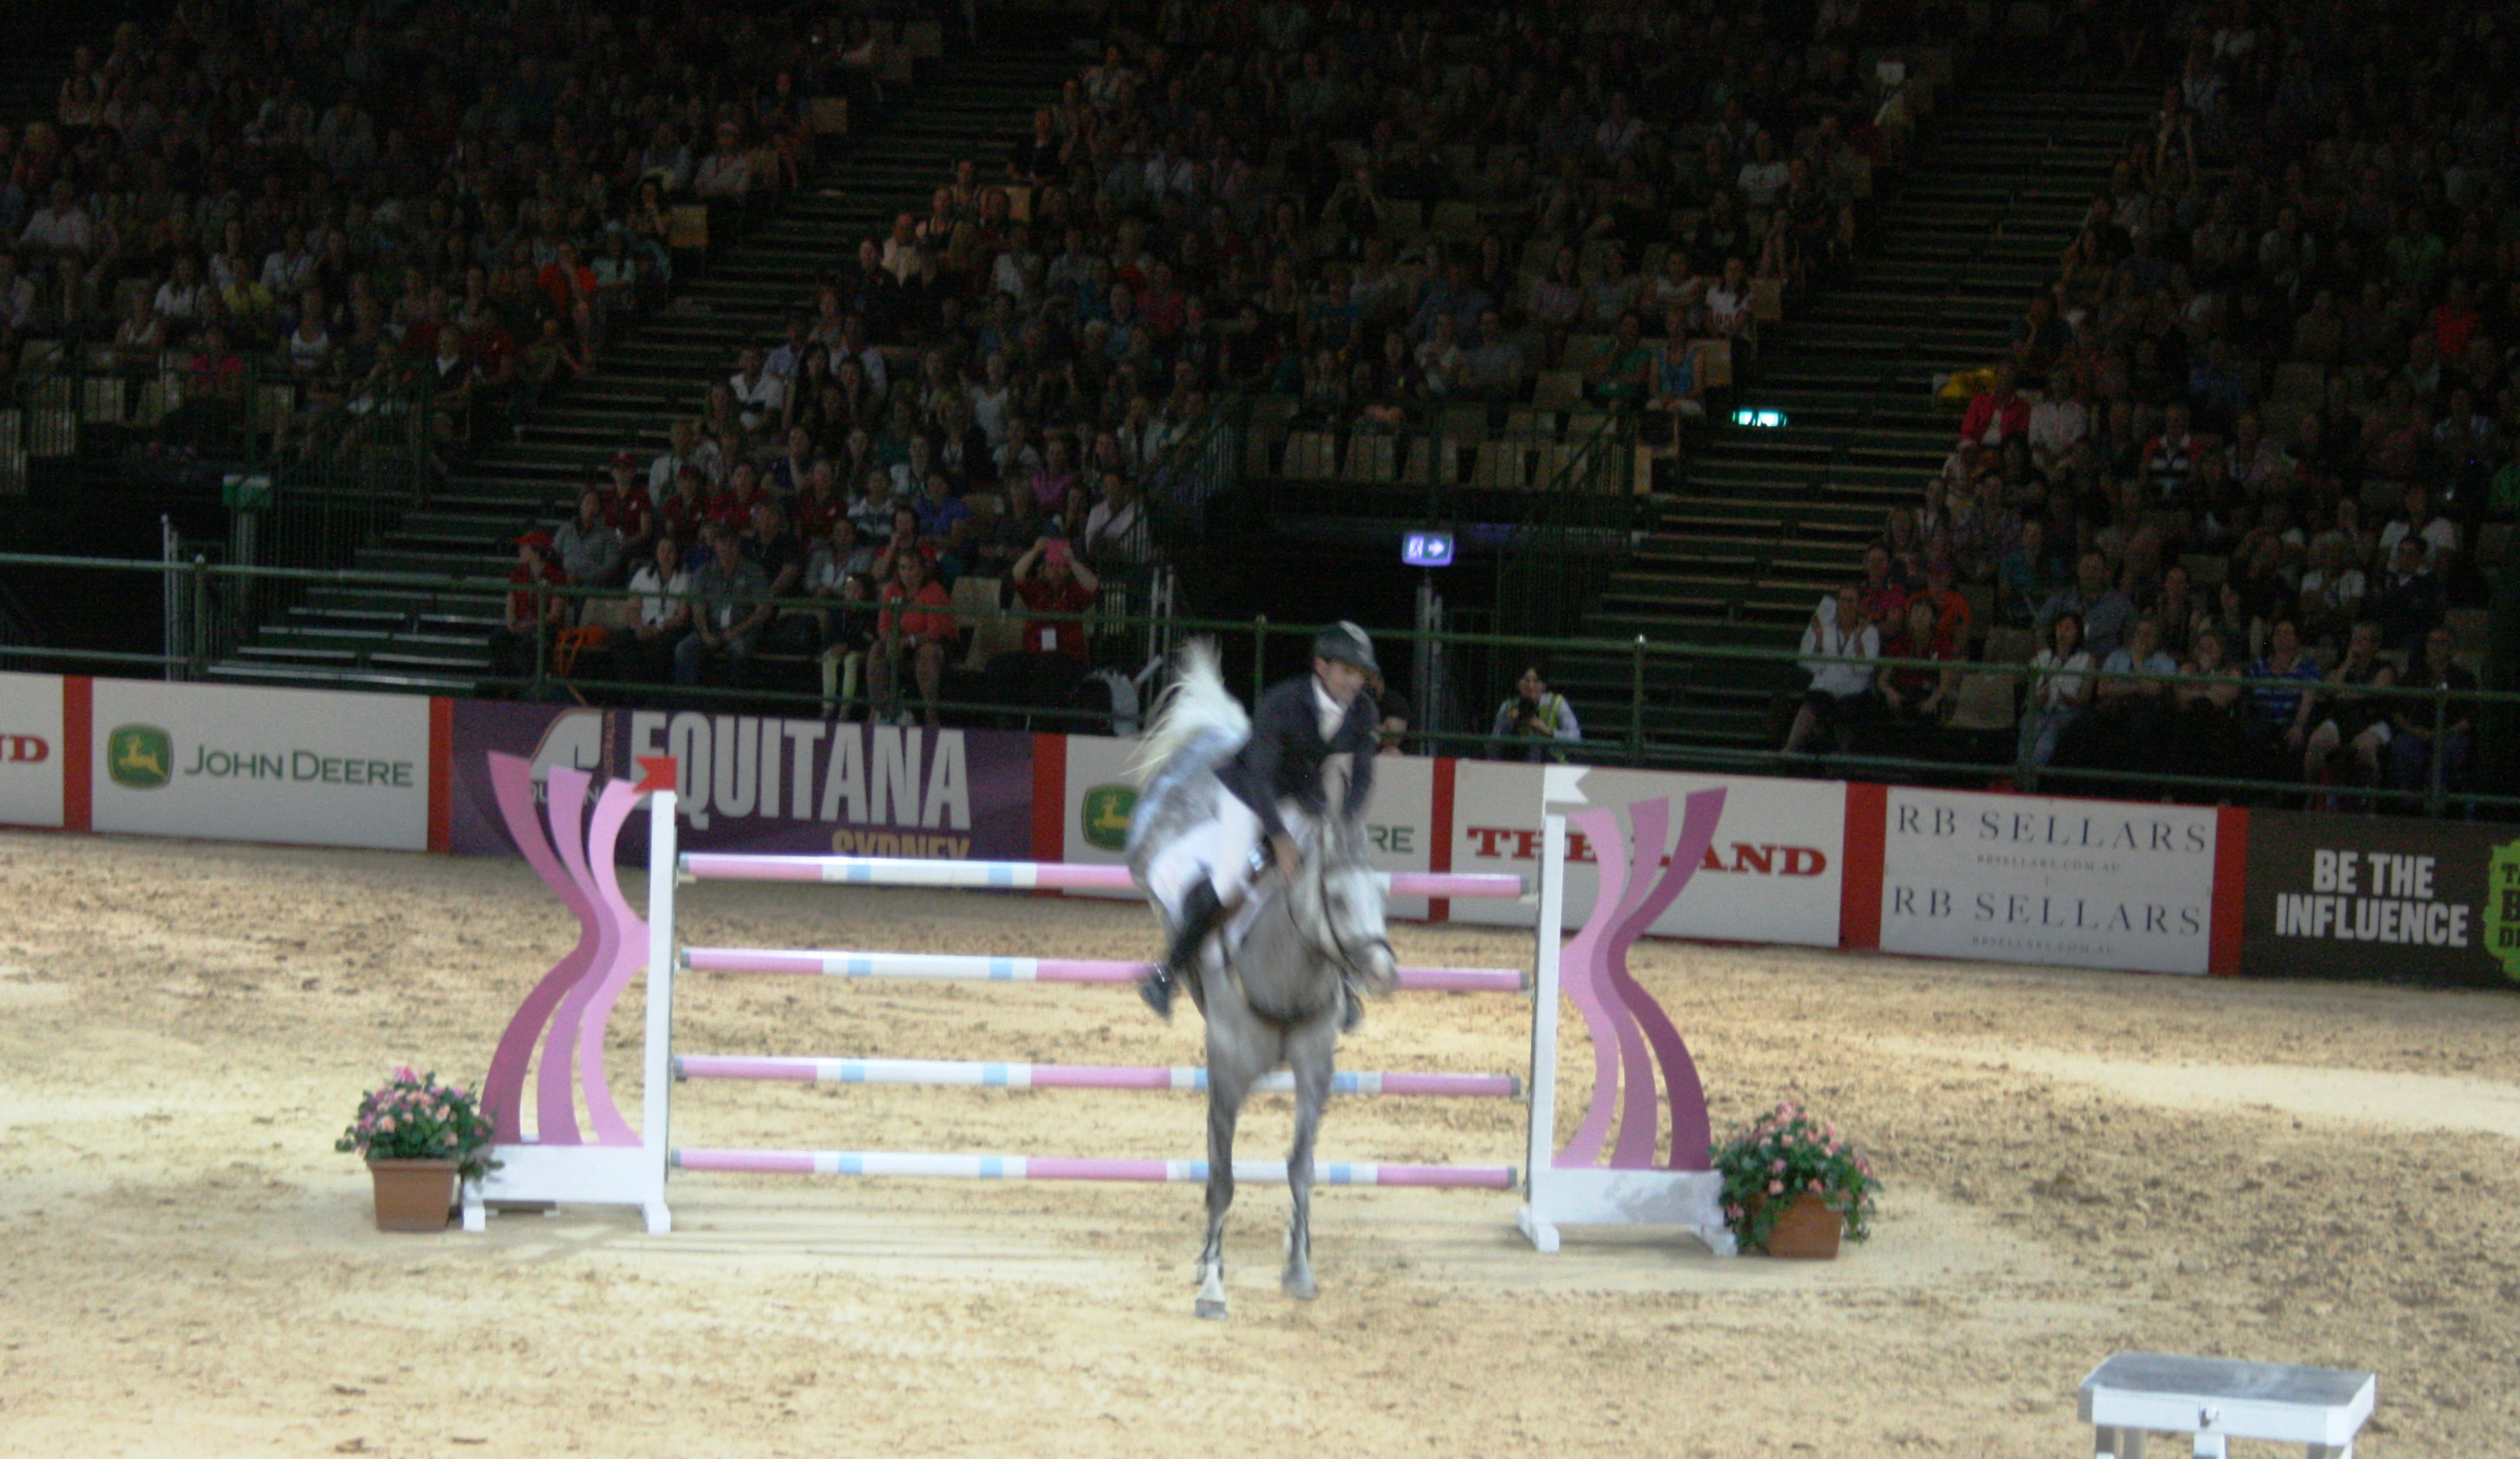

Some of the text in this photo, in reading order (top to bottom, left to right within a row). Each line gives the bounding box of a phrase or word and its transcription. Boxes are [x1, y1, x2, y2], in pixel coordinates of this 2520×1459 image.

[184, 745, 414, 788] JOHN DEERE
[629, 710, 971, 831] EQUITANA
[1898, 804, 2206, 854] RB SELLARS
[2313, 849, 2436, 900] BE THE
[1893, 885, 2201, 935] RB SELLARS
[2275, 892, 2470, 948] INFLUENCE
